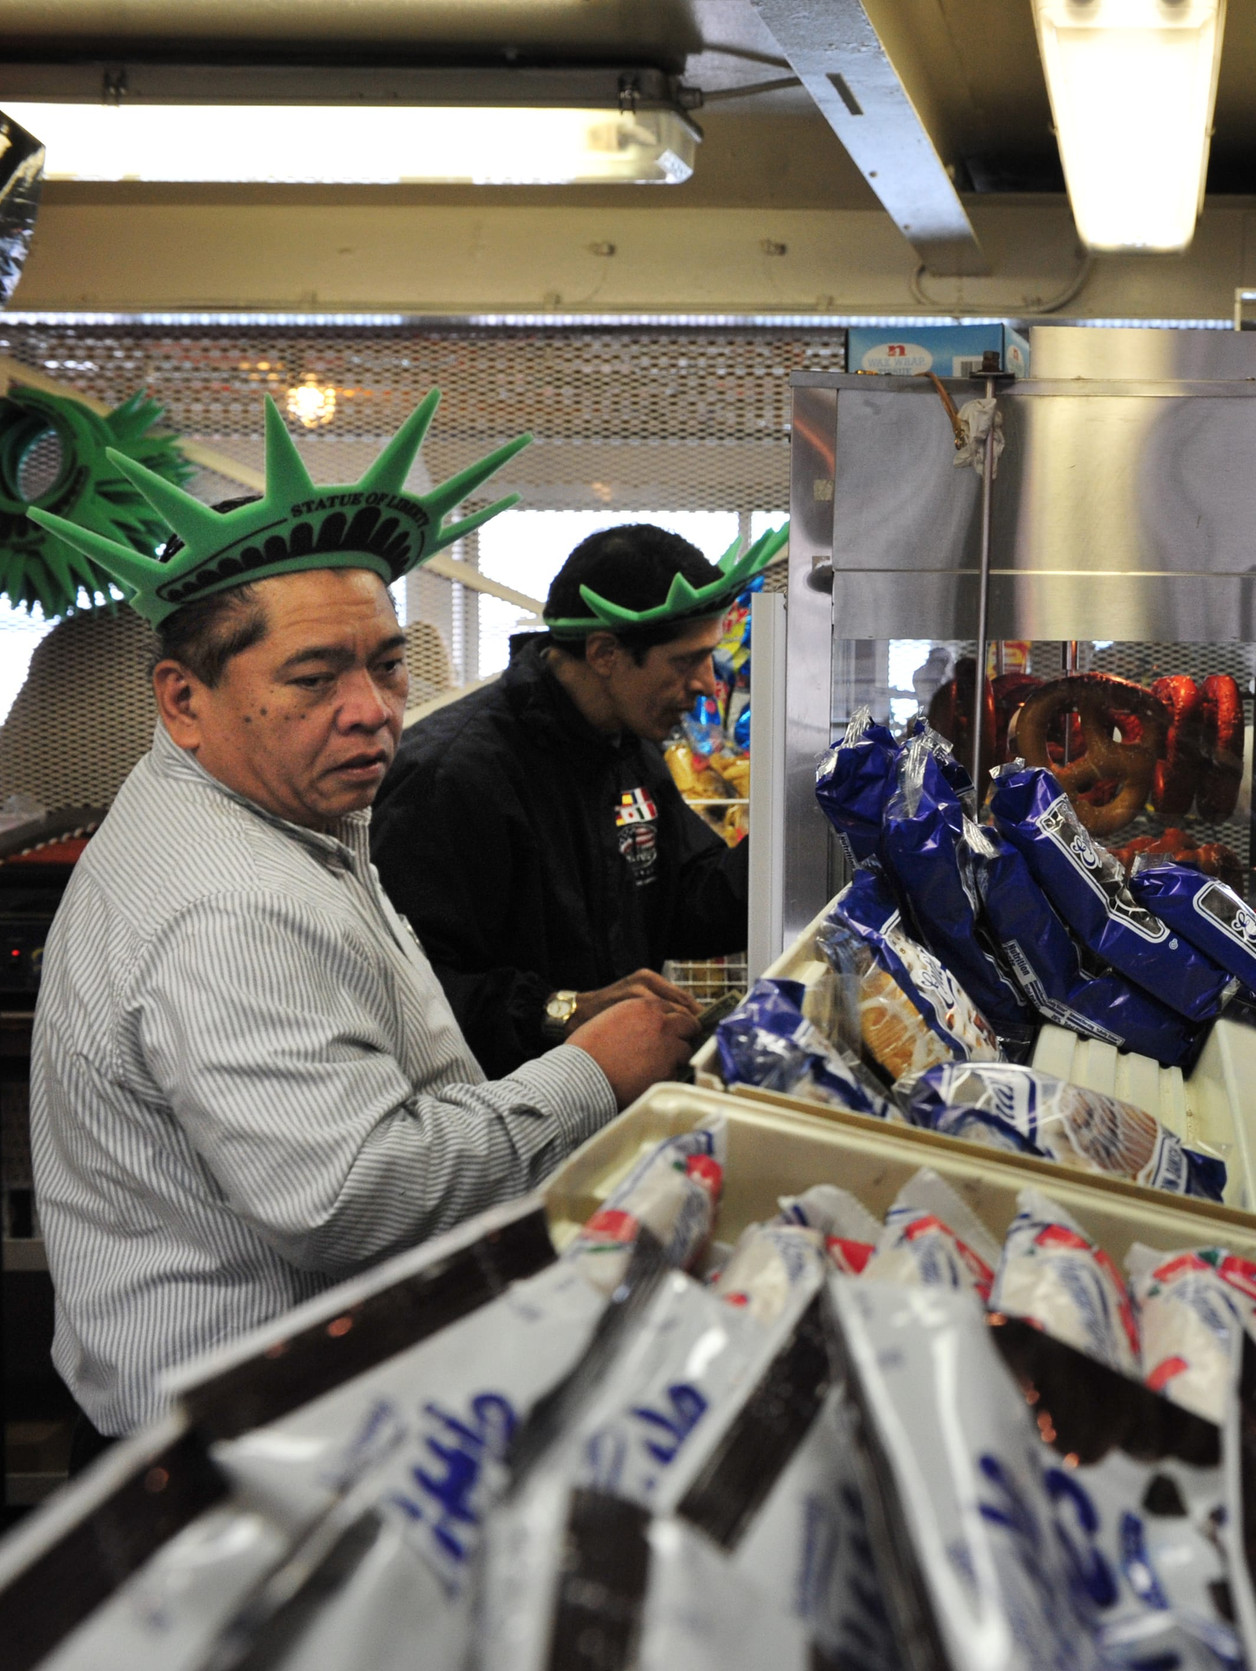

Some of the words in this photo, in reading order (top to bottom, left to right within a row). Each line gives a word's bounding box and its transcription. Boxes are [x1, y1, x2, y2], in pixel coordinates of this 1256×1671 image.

[895, 356, 926, 367] WRAP
[291, 493, 364, 517] STATUE
[365, 492, 389, 505] OF
[387, 495, 429, 528] LIBERTY
[1007, 943, 1030, 976] Nutrition
